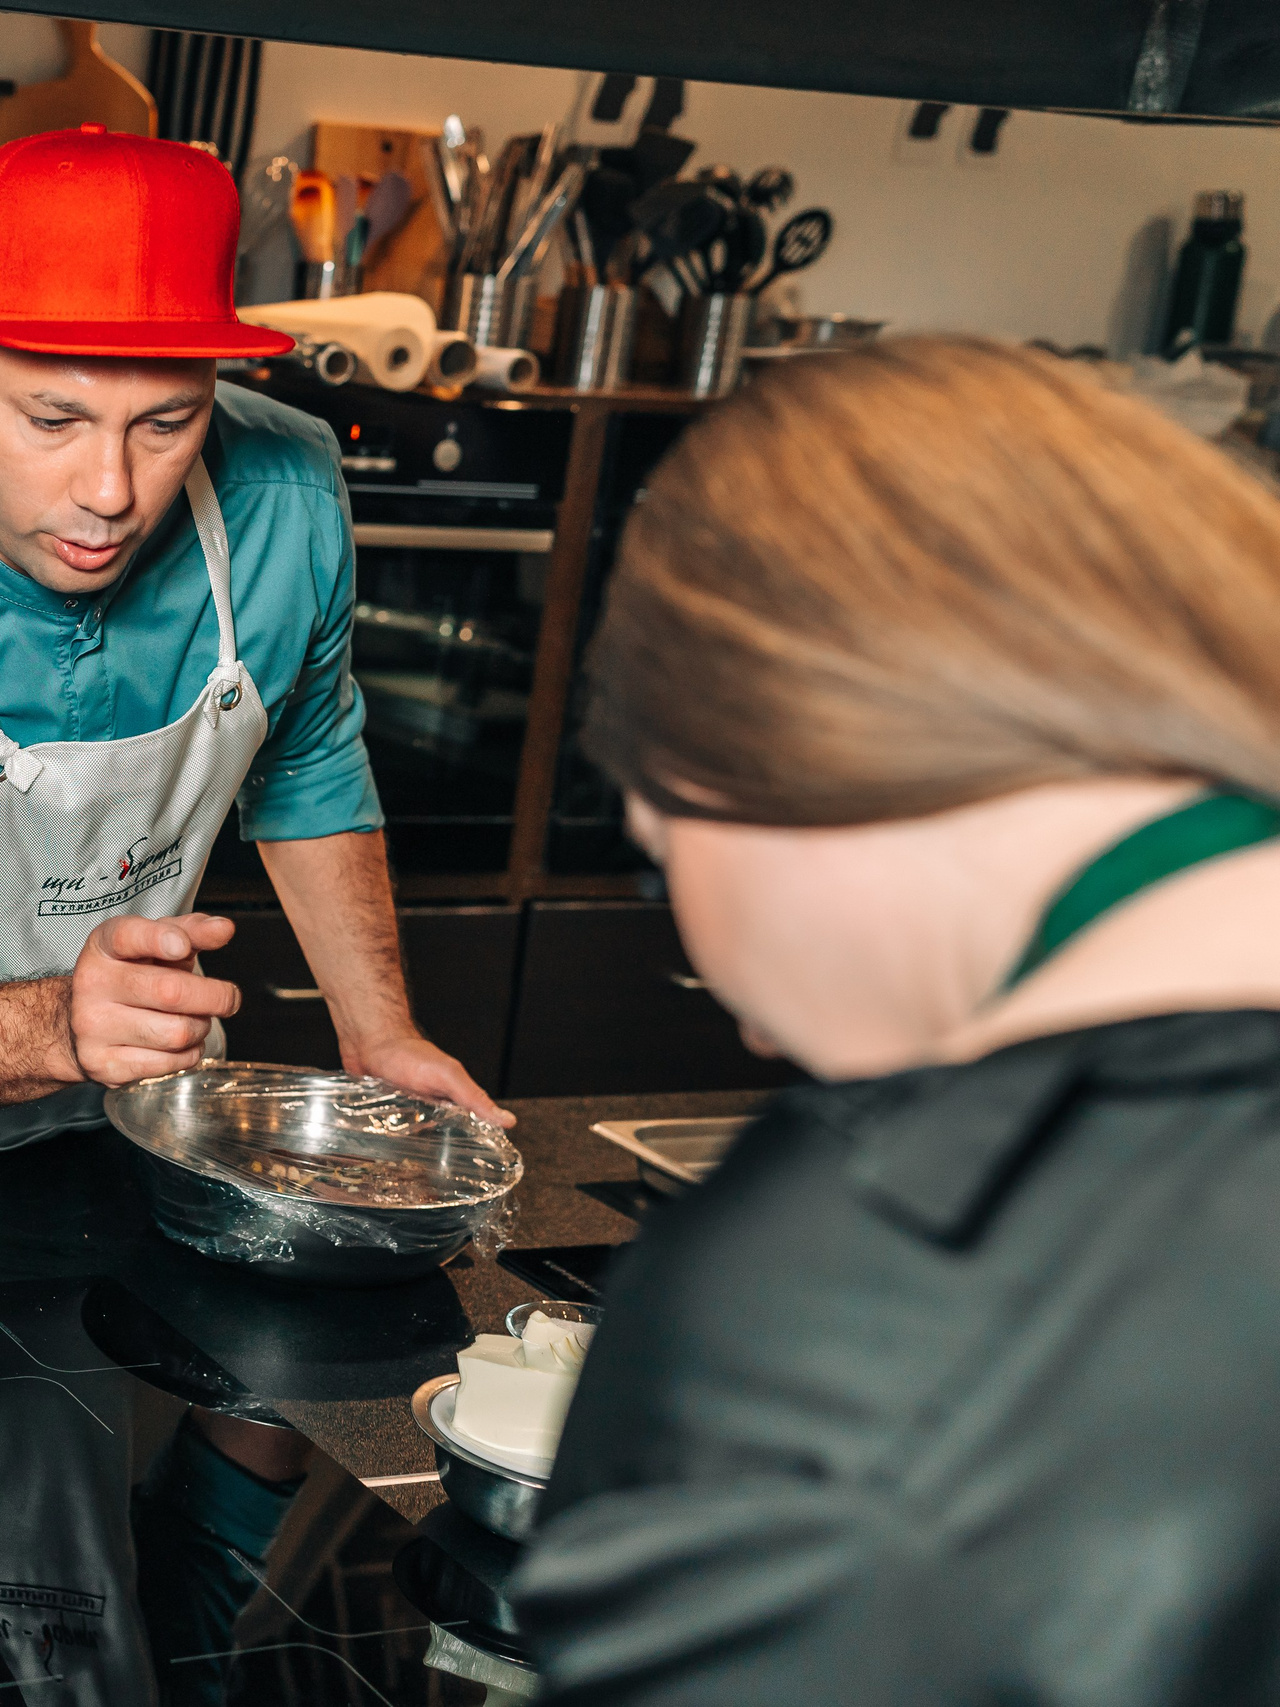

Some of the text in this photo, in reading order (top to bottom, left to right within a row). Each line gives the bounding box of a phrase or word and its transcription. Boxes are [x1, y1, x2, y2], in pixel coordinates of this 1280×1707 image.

[42, 877, 85, 900] щи
[51, 868, 171, 912] КУЛИНАРНАЯ СТУДИЯ
